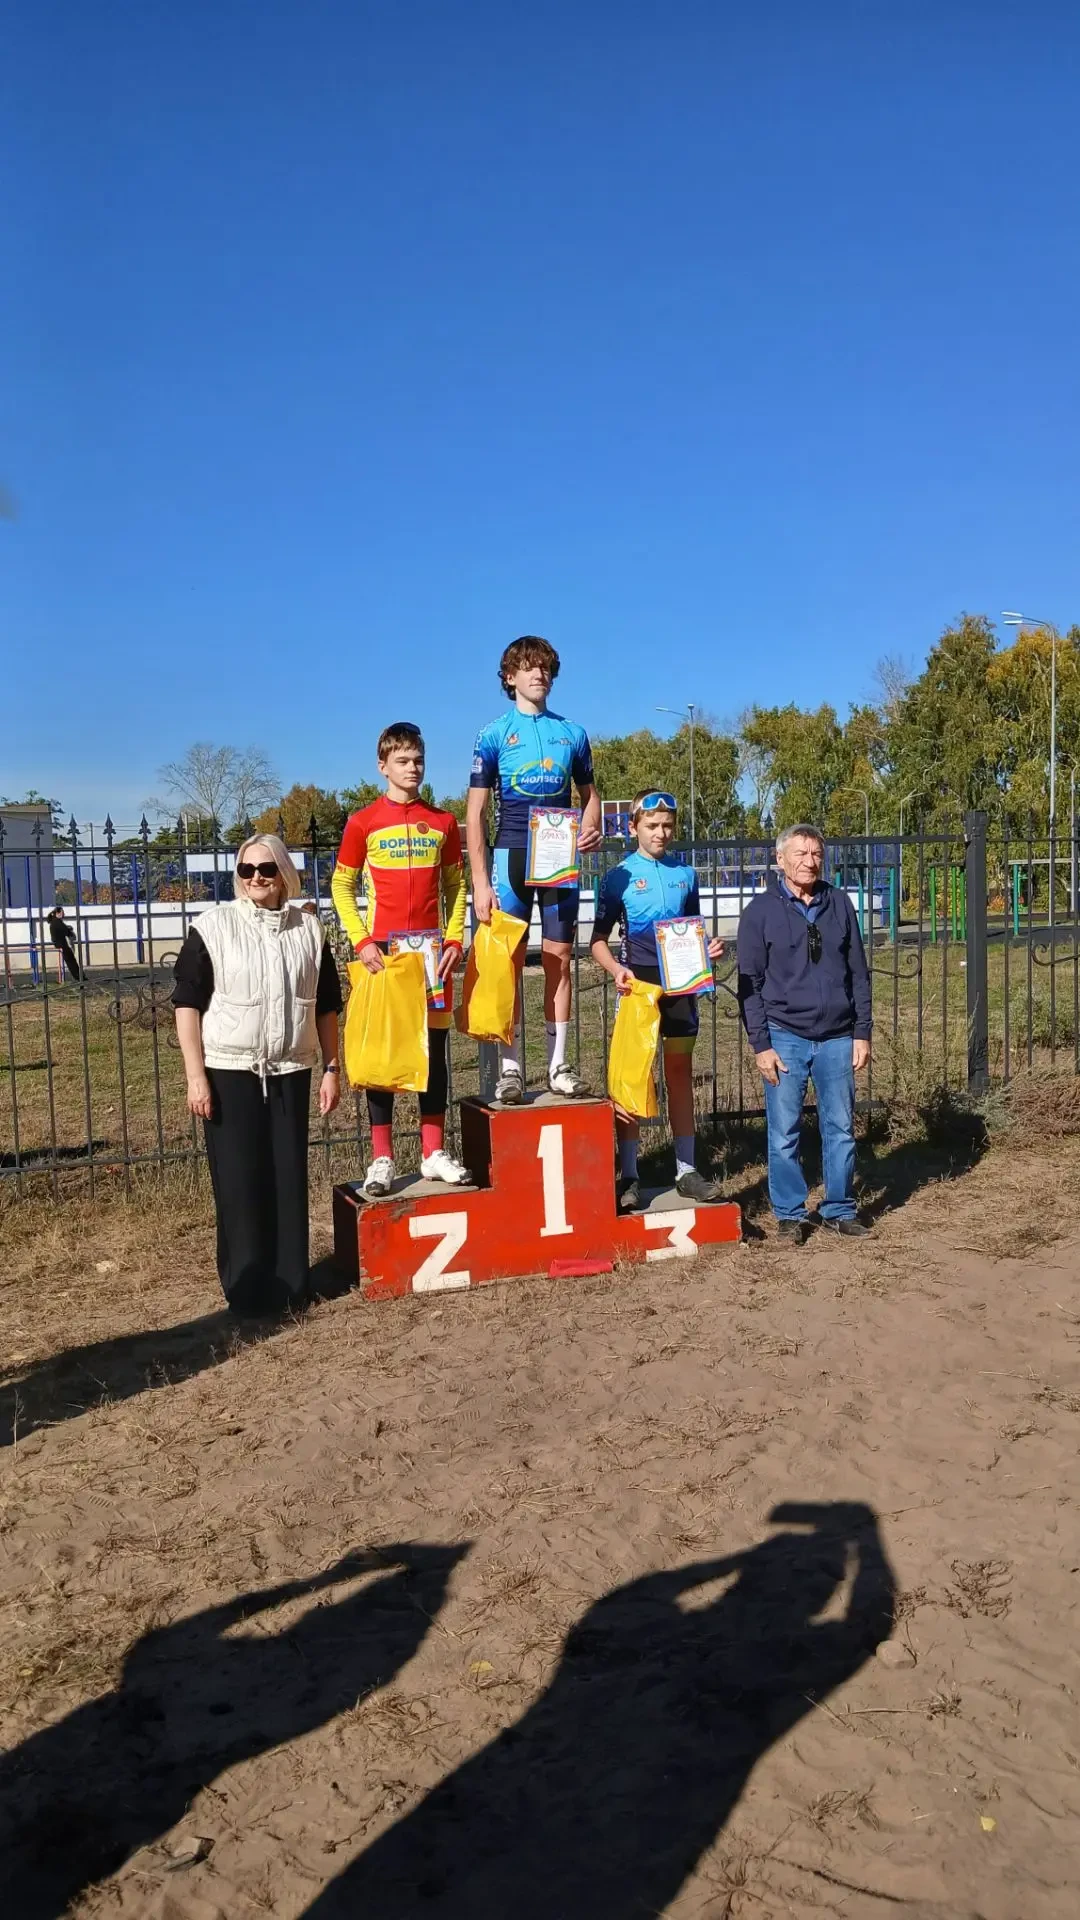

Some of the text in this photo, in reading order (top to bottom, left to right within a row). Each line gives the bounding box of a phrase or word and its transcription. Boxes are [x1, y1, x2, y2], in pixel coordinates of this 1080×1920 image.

[520, 775, 565, 784] МОЛВЕСТ
[379, 837, 438, 849] ВОРОНЕЖ
[536, 1124, 574, 1237] 1
[408, 1211, 471, 1293] 2
[643, 1208, 699, 1263] 3
